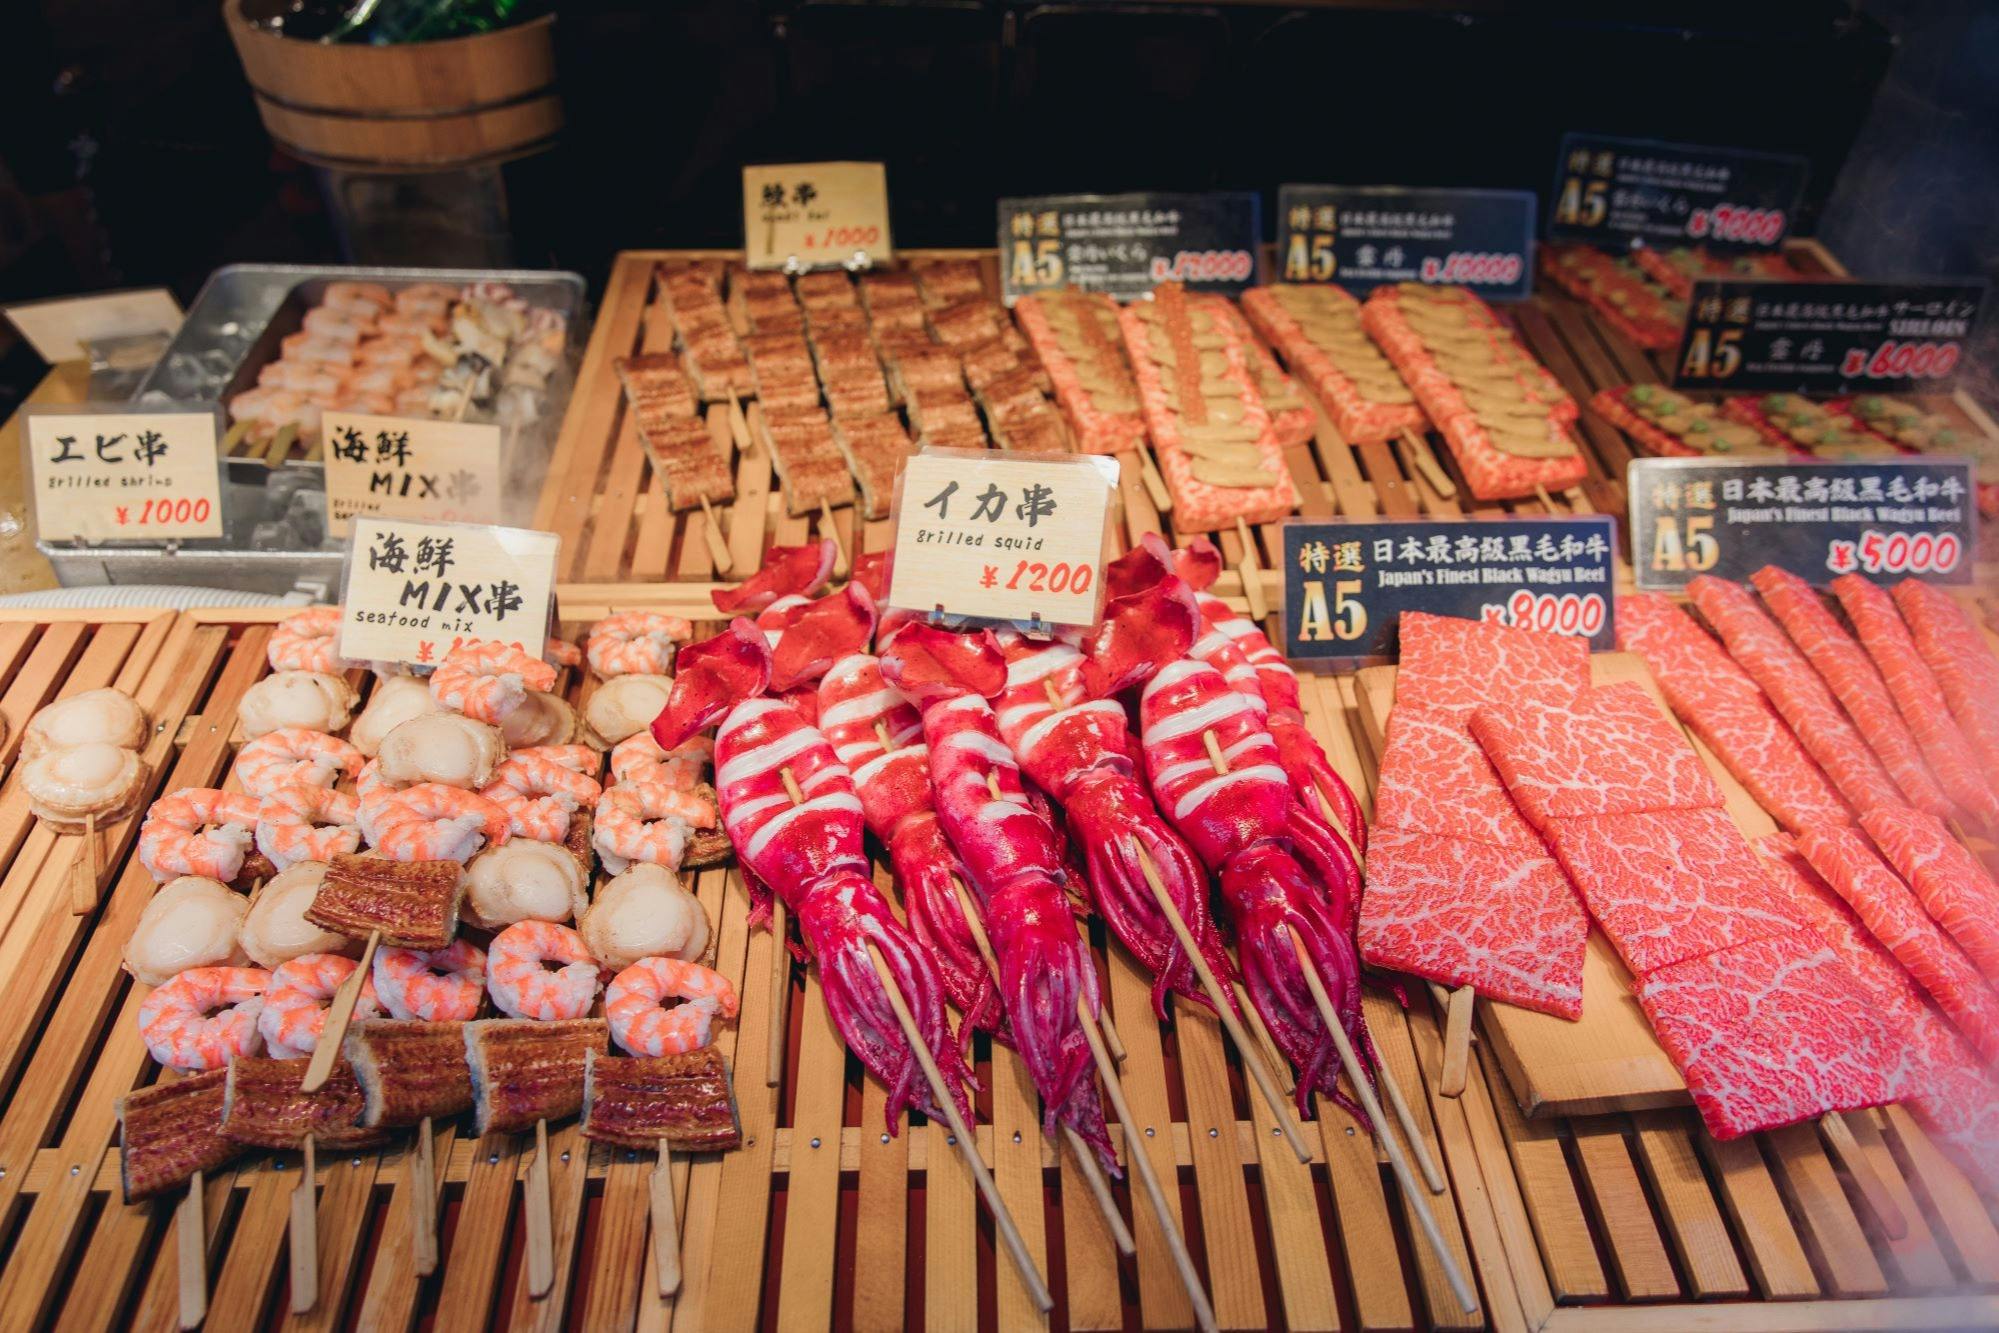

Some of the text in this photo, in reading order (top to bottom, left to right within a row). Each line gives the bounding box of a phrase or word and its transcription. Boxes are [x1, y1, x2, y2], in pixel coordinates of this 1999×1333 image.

[1556, 178, 1608, 227] A5
[1010, 240, 1063, 286] A5
[1285, 233, 1337, 281] A5
[1680, 328, 1743, 378] A5
[1839, 340, 1960, 379] ¥6000
[50, 430, 168, 467] エビ串
[331, 425, 413, 468] 海鮮
[923, 480, 1058, 528] イカ串
[1652, 481, 1718, 510] 特選
[1722, 475, 1967, 504] 日本最高級黒毛和牛
[116, 498, 210, 525] ¥1000
[369, 532, 455, 578] 海鮮
[916, 529, 1044, 551] grilled squid
[1299, 540, 1366, 573] 特選
[1373, 534, 1610, 565] 日本最高級黒毛和牛
[1652, 515, 1719, 571] A5
[1826, 530, 1962, 573] ¥5000
[979, 559, 1093, 595] ¥1200
[1378, 566, 1606, 588] Japan's Finest Black Wagyu Beef
[399, 580, 524, 622] MIX串
[1298, 579, 1368, 641] A5
[355, 610, 474, 633] seafood mix
